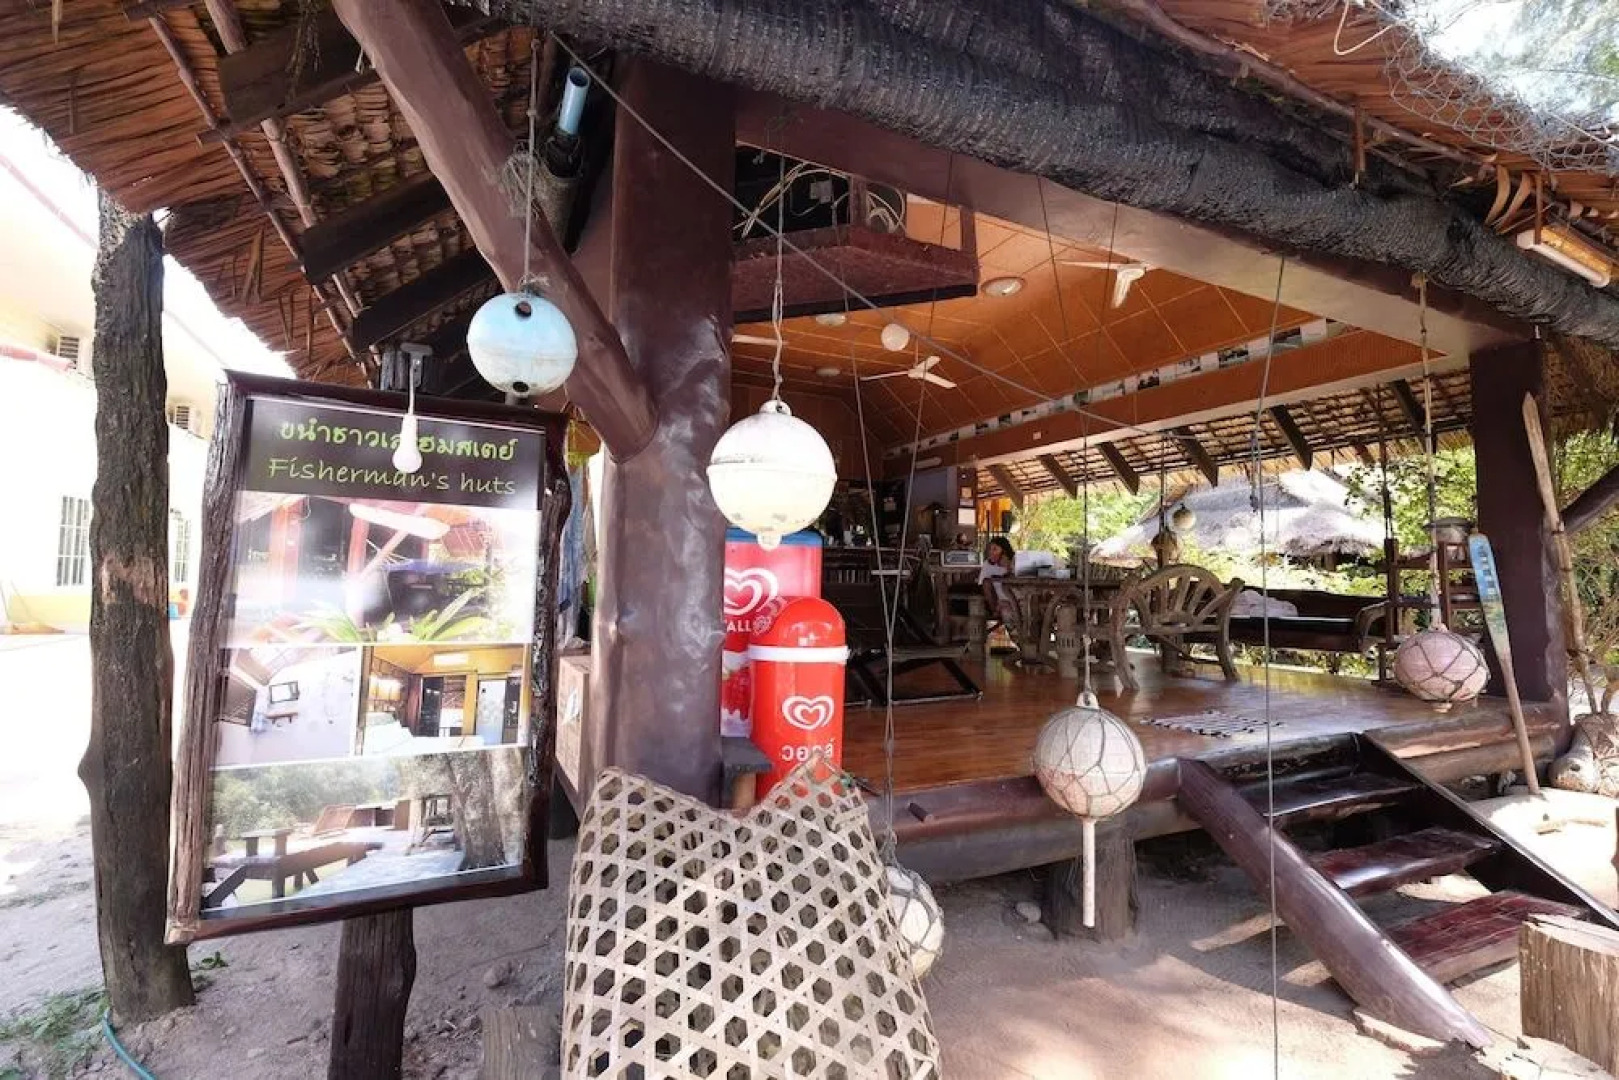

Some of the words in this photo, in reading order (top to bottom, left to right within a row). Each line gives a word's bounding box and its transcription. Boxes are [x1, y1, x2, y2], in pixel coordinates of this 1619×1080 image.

[269, 456, 450, 490] Fisherman's
[460, 472, 516, 495] huts
[724, 619, 752, 632] ALL
